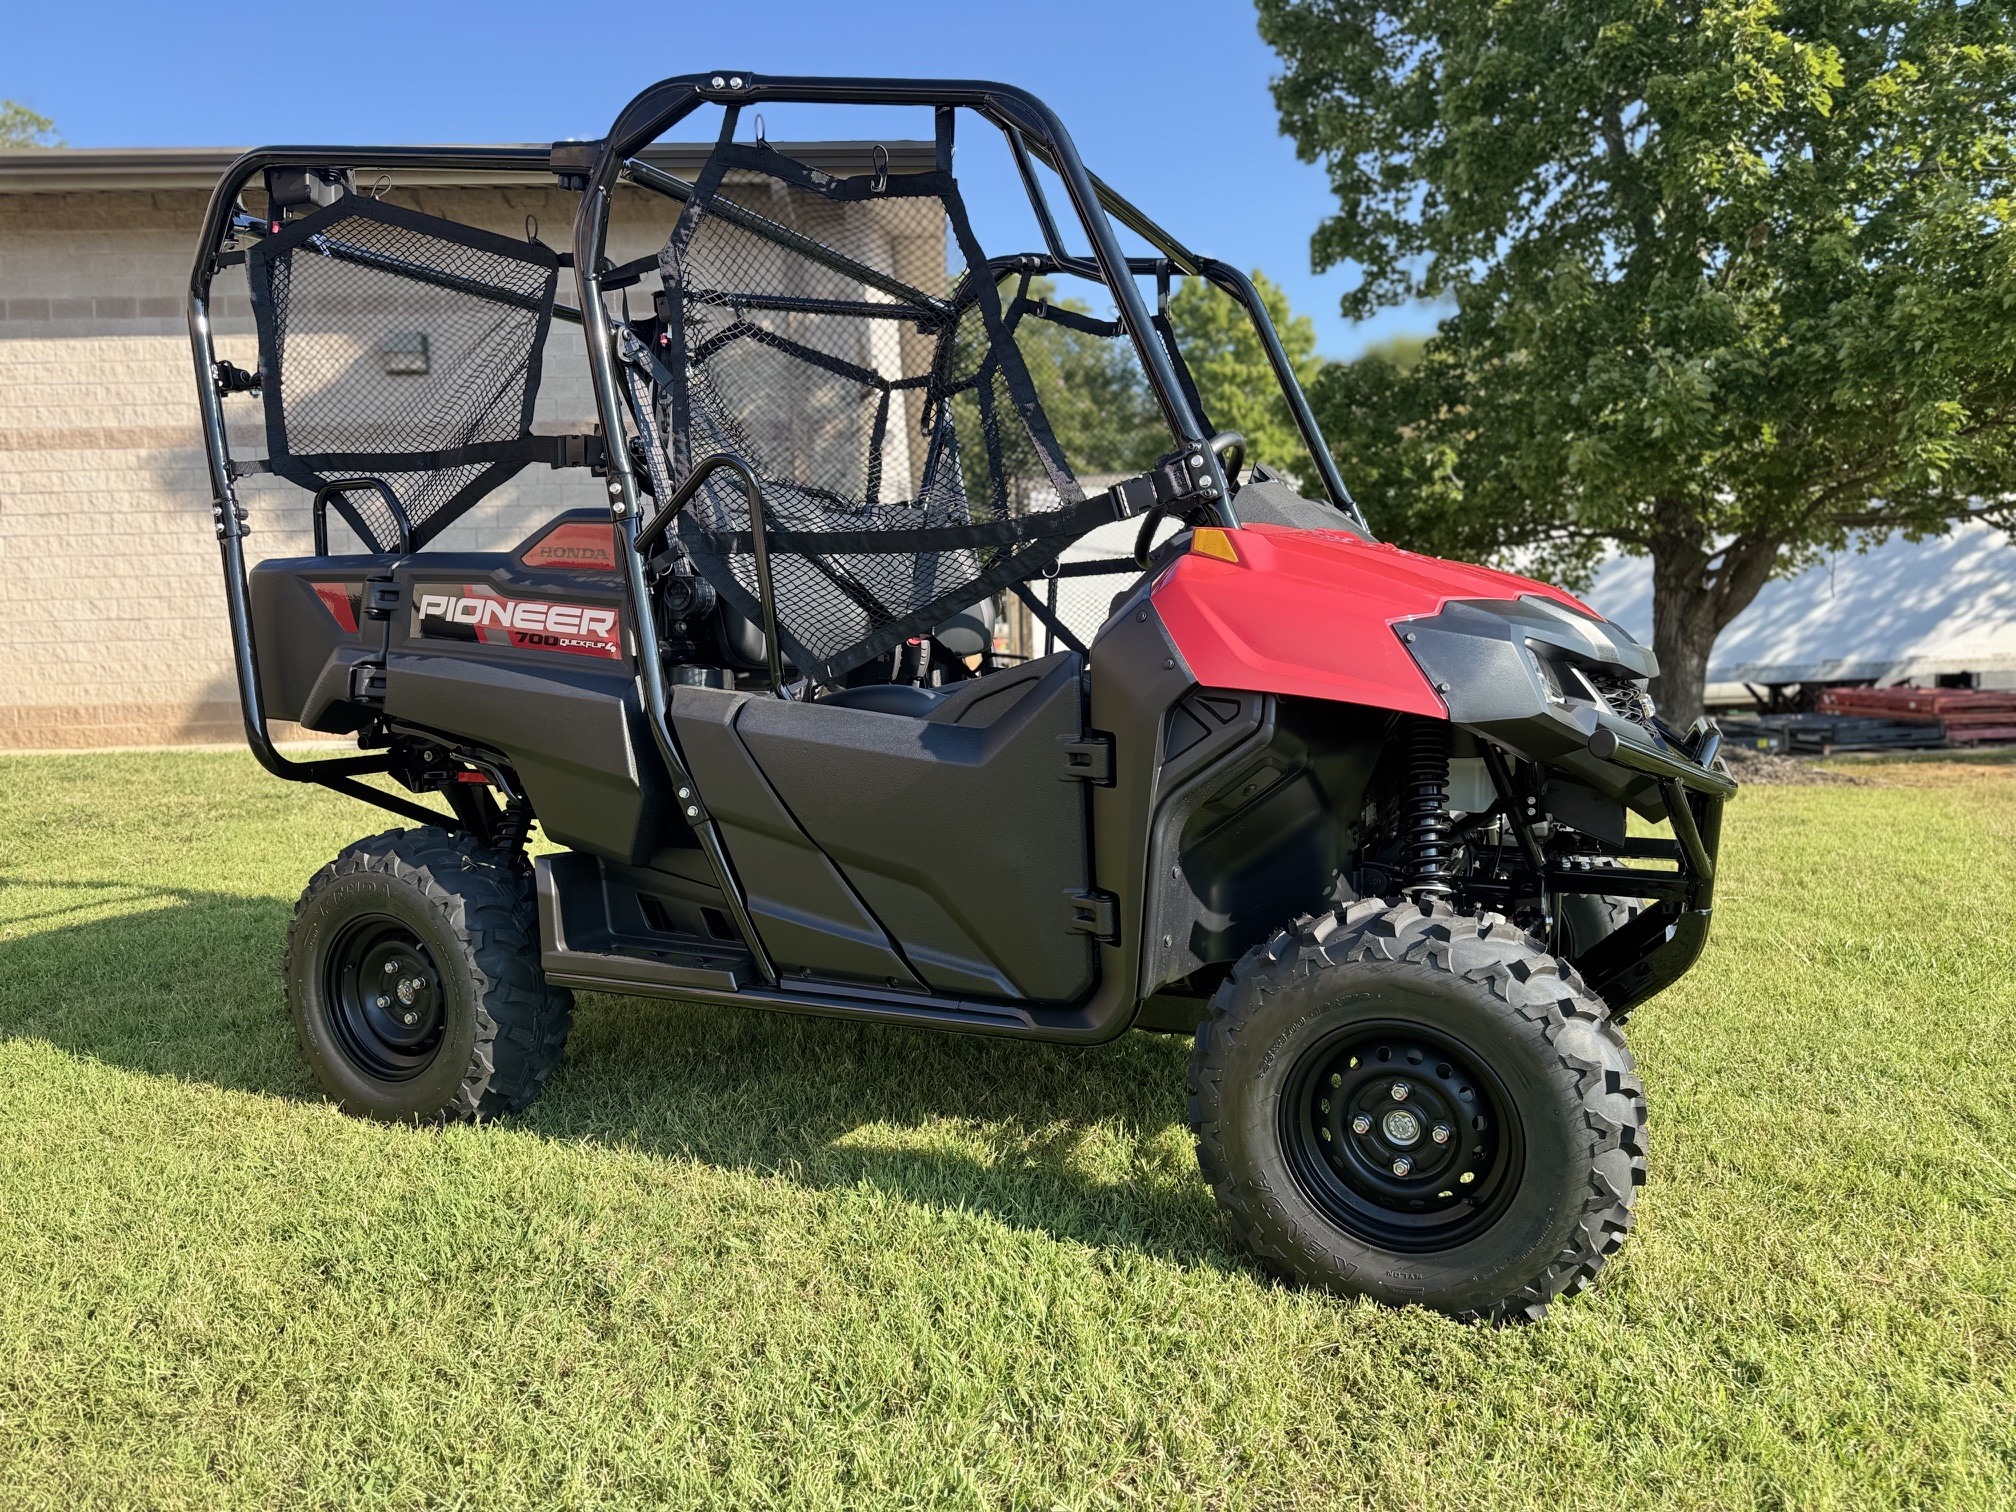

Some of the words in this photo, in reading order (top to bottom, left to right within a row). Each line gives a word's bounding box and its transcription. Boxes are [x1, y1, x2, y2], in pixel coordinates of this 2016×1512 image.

[539, 546, 609, 560] HONDA
[419, 595, 616, 637] PIONEER
[514, 631, 559, 647] 700
[1249, 1170, 1359, 1282] KENDA
[1386, 1270, 1423, 1281] NYLON
